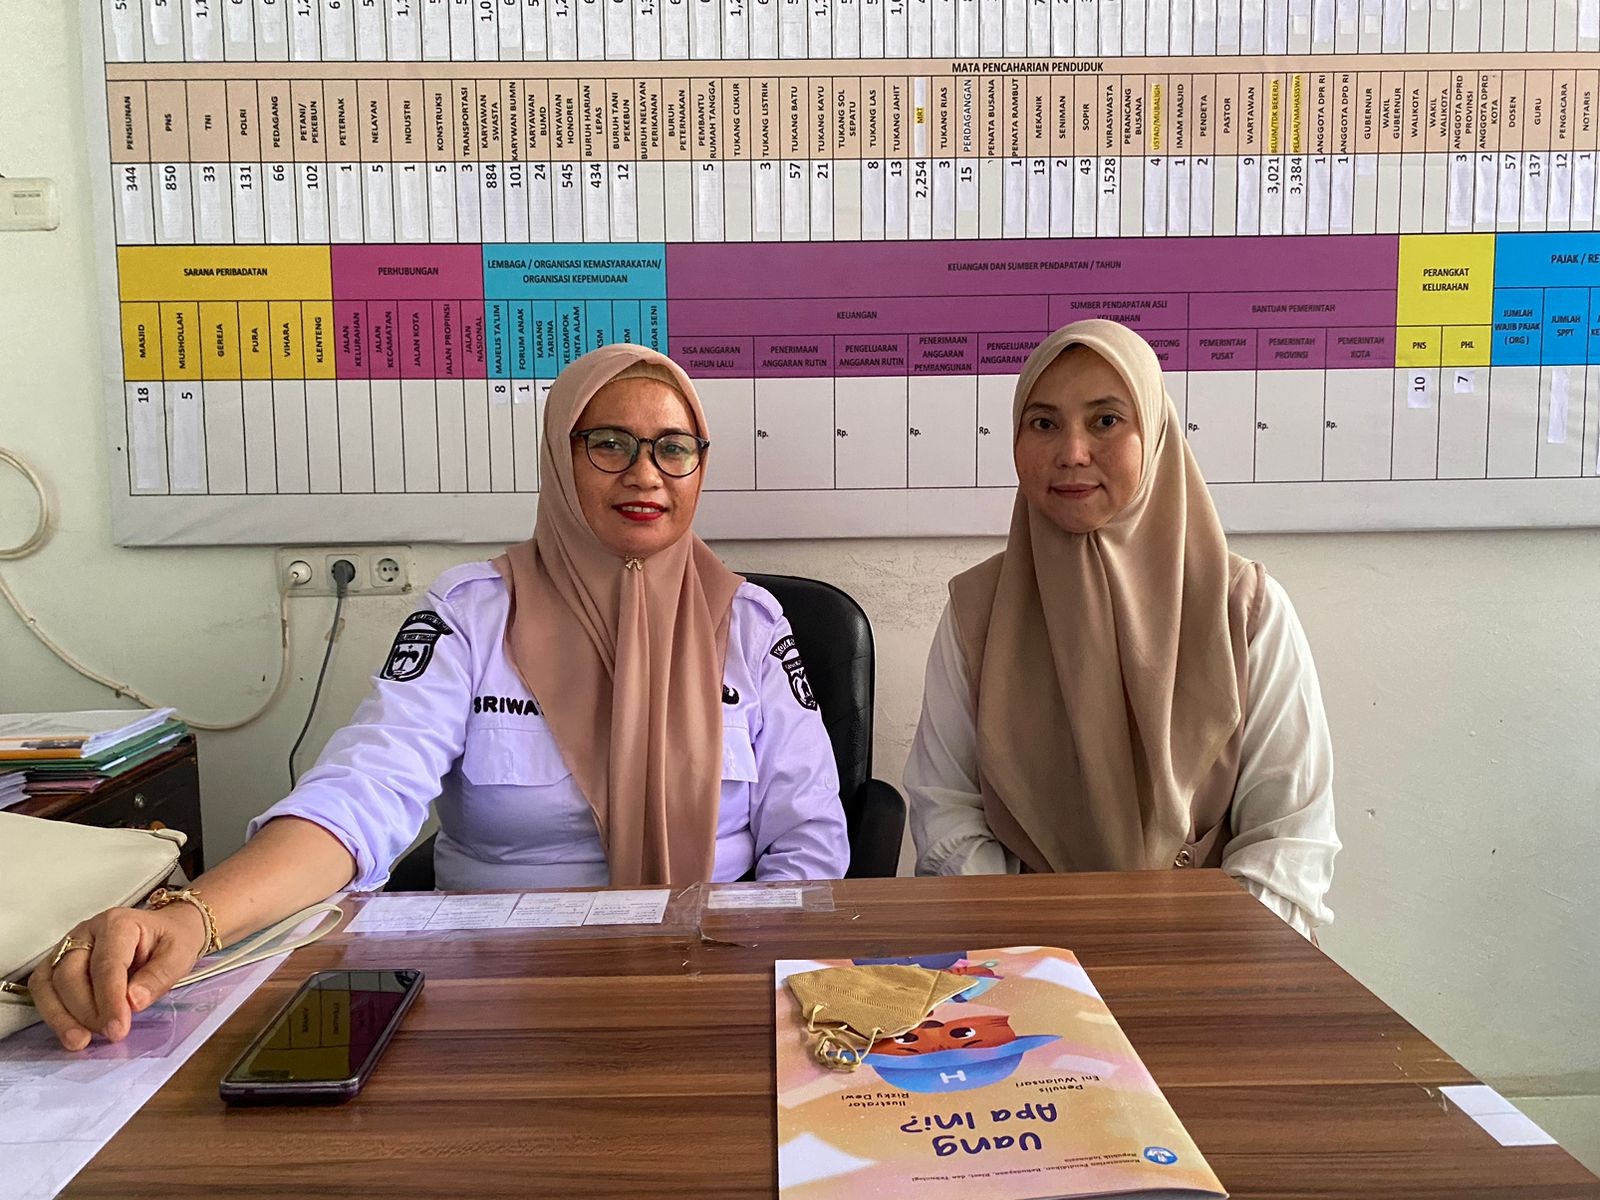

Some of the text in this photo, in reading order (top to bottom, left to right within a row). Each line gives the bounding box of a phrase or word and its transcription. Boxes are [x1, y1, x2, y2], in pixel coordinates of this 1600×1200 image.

[952, 62, 1103, 72] MATA PENCAHARIAN PENDUDUK
[1341, 74, 1349, 84] RI
[790, 86, 798, 110] BATU
[892, 85, 900, 109] JAHIT
[204, 114, 212, 130] TNI
[271, 96, 280, 148] PEDAGANG
[337, 98, 346, 146] PETERNAK
[403, 100, 411, 144] INDUSTRI
[435, 93, 443, 151] KONSTRUKSI
[460, 87, 469, 156] TRANSPORTASI
[553, 94, 562, 148] KARYAWAN
[566, 98, 574, 144] HONORER
[667, 104, 675, 136] BURUH
[678, 90, 686, 150] PETERNAKAN
[939, 87, 947, 150] TUKANG RIAS
[963, 80, 972, 152] PERDAGANGAN
[1058, 96, 1066, 139] SENIMAN
[1082, 104, 1090, 131] SOPIR
[1105, 84, 1114, 148] WIRASWASTA
[1199, 95, 1207, 137] PENDETA
[1246, 86, 1255, 144] WARTAWAN
[1363, 88, 1372, 140] GUBERNUR
[1411, 89, 1419, 138] WALIKOTA
[1465, 91, 1473, 134] PROVINSI
[1508, 96, 1516, 128] DOSEN
[1534, 99, 1542, 125] GURU
[1559, 84, 1567, 139] PENGACARA
[1582, 91, 1590, 131] NOTARIS
[1339, 108, 1348, 153] ANGGOTA
[1453, 101, 1462, 149] ANGGOTA
[203, 166, 215, 182] 33
[273, 166, 284, 181] 66
[373, 164, 383, 172] 5
[461, 164, 472, 172] 3
[867, 161, 878, 169] 8
[1056, 160, 1068, 168] 2
[1150, 158, 1160, 166] 4
[1197, 158, 1208, 166] 2
[1505, 155, 1516, 170] 57
[1529, 155, 1540, 177] 137
[127, 167, 138, 191] 344
[165, 166, 176, 190] 850
[240, 166, 251, 190] 131
[307, 165, 318, 190] 102
[486, 164, 497, 188] 884
[510, 164, 521, 188] 101
[561, 164, 572, 188] 545
[592, 164, 602, 188] 434
[915, 161, 928, 198] 2,254
[960, 167, 972, 182] 15
[1103, 158, 1116, 195] 1,528
[1267, 158, 1280, 194] 3,021
[1290, 158, 1302, 194] 3,384
[488, 260, 526, 269] LEMBAGA
[534, 260, 581, 268] ORGANISASI
[948, 262, 988, 271] KEUANGAN
[990, 262, 1005, 270] DAN
[1008, 262, 1038, 270] SUMBER
[1040, 261, 1088, 270] PENDAPATAN
[1096, 260, 1121, 269] TAHUN
[1552, 255, 1578, 263] PAJAK
[184, 268, 267, 276] SARANA PERIBADATAN
[378, 267, 438, 276] PERHUBUNGAN
[523, 274, 627, 283] ORGANISASI KEPEMUDAAN
[1423, 268, 1469, 276] PERANGKAT
[1423, 283, 1469, 291] KELURAHAN
[837, 311, 877, 319] KEUANGAN
[1071, 300, 1167, 309] SUMBER PENDAPATAN ASLI
[1252, 304, 1335, 313] BANTUAN PEMERINTAH
[412, 313, 420, 337] KOTA
[138, 324, 146, 358] MASJID
[176, 312, 185, 368] MUSHOLLAH
[314, 316, 322, 362] KLENTENG
[342, 326, 350, 353] JALAN
[353, 312, 361, 367] KELURAHAN
[535, 320, 544, 358] KARANG
[562, 314, 570, 364] KELOMPOK
[845, 344, 898, 353] PENGELUARAN
[1200, 338, 1246, 346] PEMERINTAH
[518, 336, 526, 370] FORUM
[762, 359, 827, 368] ANGGARAN RUTIN
[839, 357, 904, 367] ANGGARAN RUTIN
[1211, 352, 1233, 360] PUSAT
[137, 387, 148, 402] 18
[182, 392, 192, 400] 5
[1414, 377, 1425, 392] 10
[758, 430, 768, 439] Rp.
[837, 429, 848, 438] Rp.
[910, 428, 921, 437] Rp.
[979, 427, 990, 435] Rp.
[474, 696, 544, 715] SRIWA
[1016, 1075, 1099, 1088] Eni Wulansari
[1039, 1084, 1083, 1093] Penulis
[992, 1103, 1057, 1124] Apa
[934, 1132, 1042, 1157] Uang
